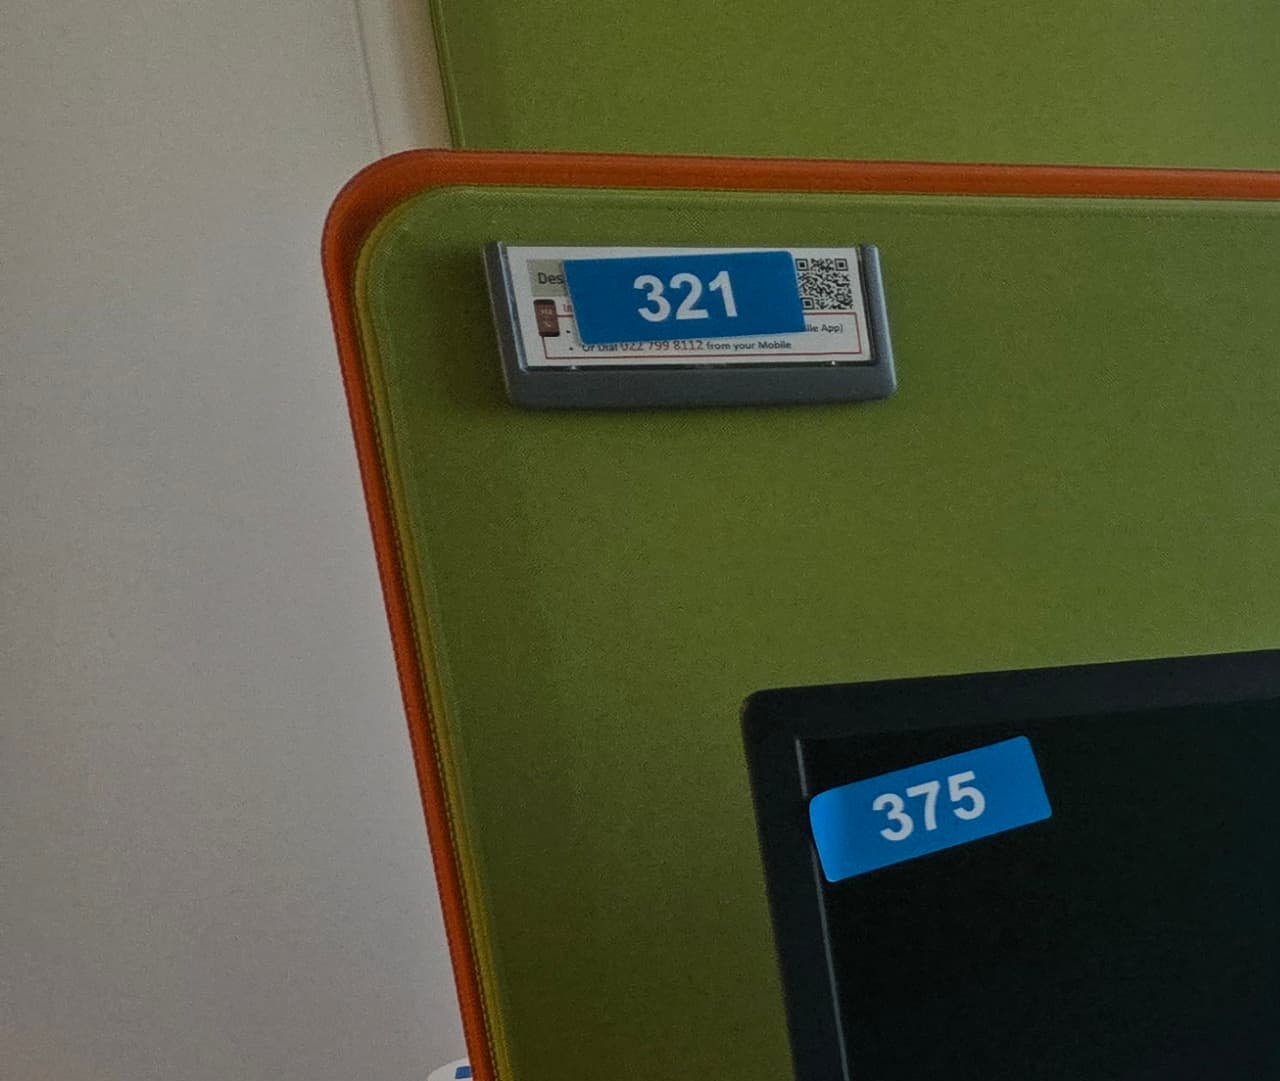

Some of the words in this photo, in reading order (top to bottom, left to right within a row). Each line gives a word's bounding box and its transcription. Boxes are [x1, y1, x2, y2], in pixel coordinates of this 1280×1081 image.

[537, 271, 565, 285] Des
[634, 271, 738, 323] 321
[821, 323, 844, 334] App)
[621, 341, 644, 352] 022
[649, 340, 670, 351] 799
[672, 339, 704, 351] 8112
[706, 340, 731, 350] from
[732, 342, 755, 351] your
[758, 340, 793, 350] Mobile
[872, 770, 986, 842] 375
